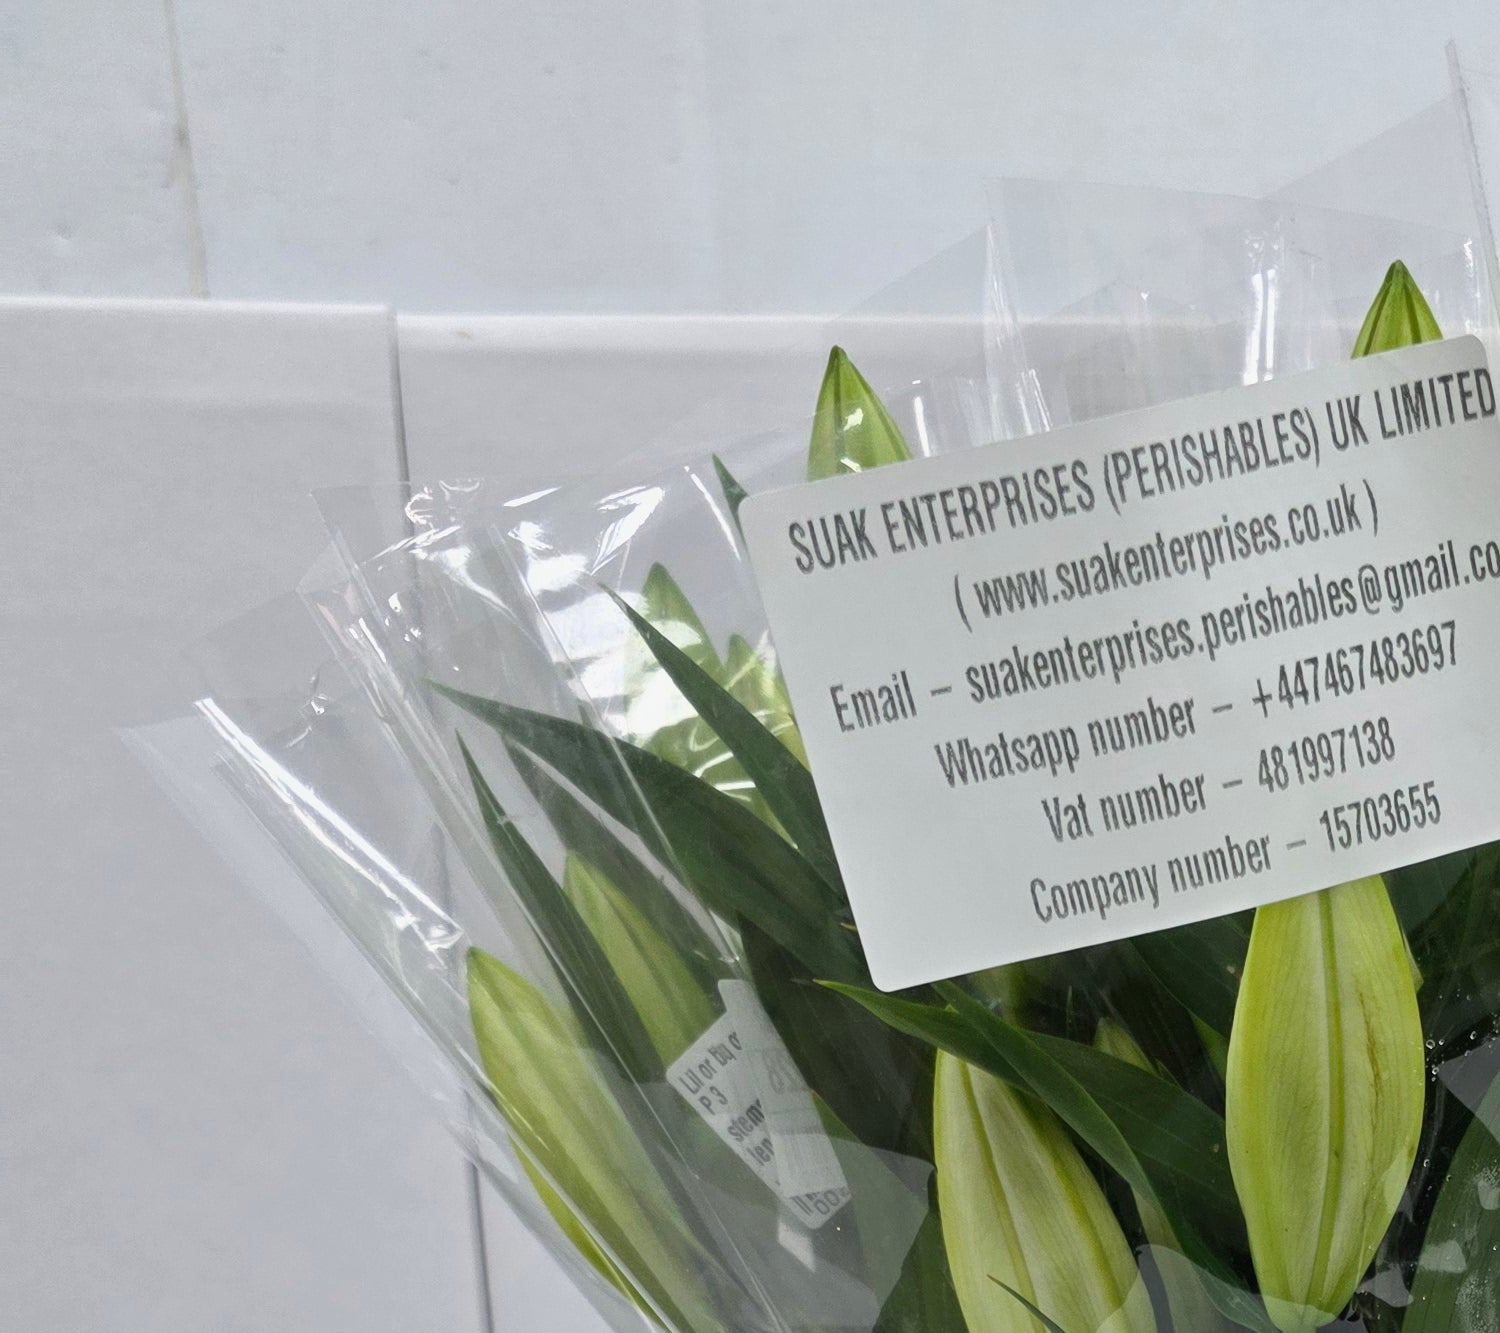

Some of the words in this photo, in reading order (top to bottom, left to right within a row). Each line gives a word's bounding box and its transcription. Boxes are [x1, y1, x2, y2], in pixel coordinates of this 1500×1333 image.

[789, 508, 877, 573] SUAK
[881, 460, 1095, 553] ENTERPRISES
[1104, 409, 1319, 514] (PERISHABLES)
[1326, 395, 1368, 450] UK
[1374, 367, 1496, 439] LIMITED
[973, 484, 1361, 617] www.suakenterprises.co.uk
[830, 670, 916, 732] Email
[934, 727, 1079, 787] Whatsapp
[1088, 697, 1195, 756] number
[1253, 620, 1456, 717] +447467483697
[1041, 794, 1093, 842] Vat
[1100, 775, 1205, 831] number
[1259, 717, 1395, 792] 481997138
[1030, 866, 1159, 922] Company
[1168, 836, 1270, 892] number
[1320, 781, 1440, 851] 15703655
[727, 1099, 766, 1142] stem
